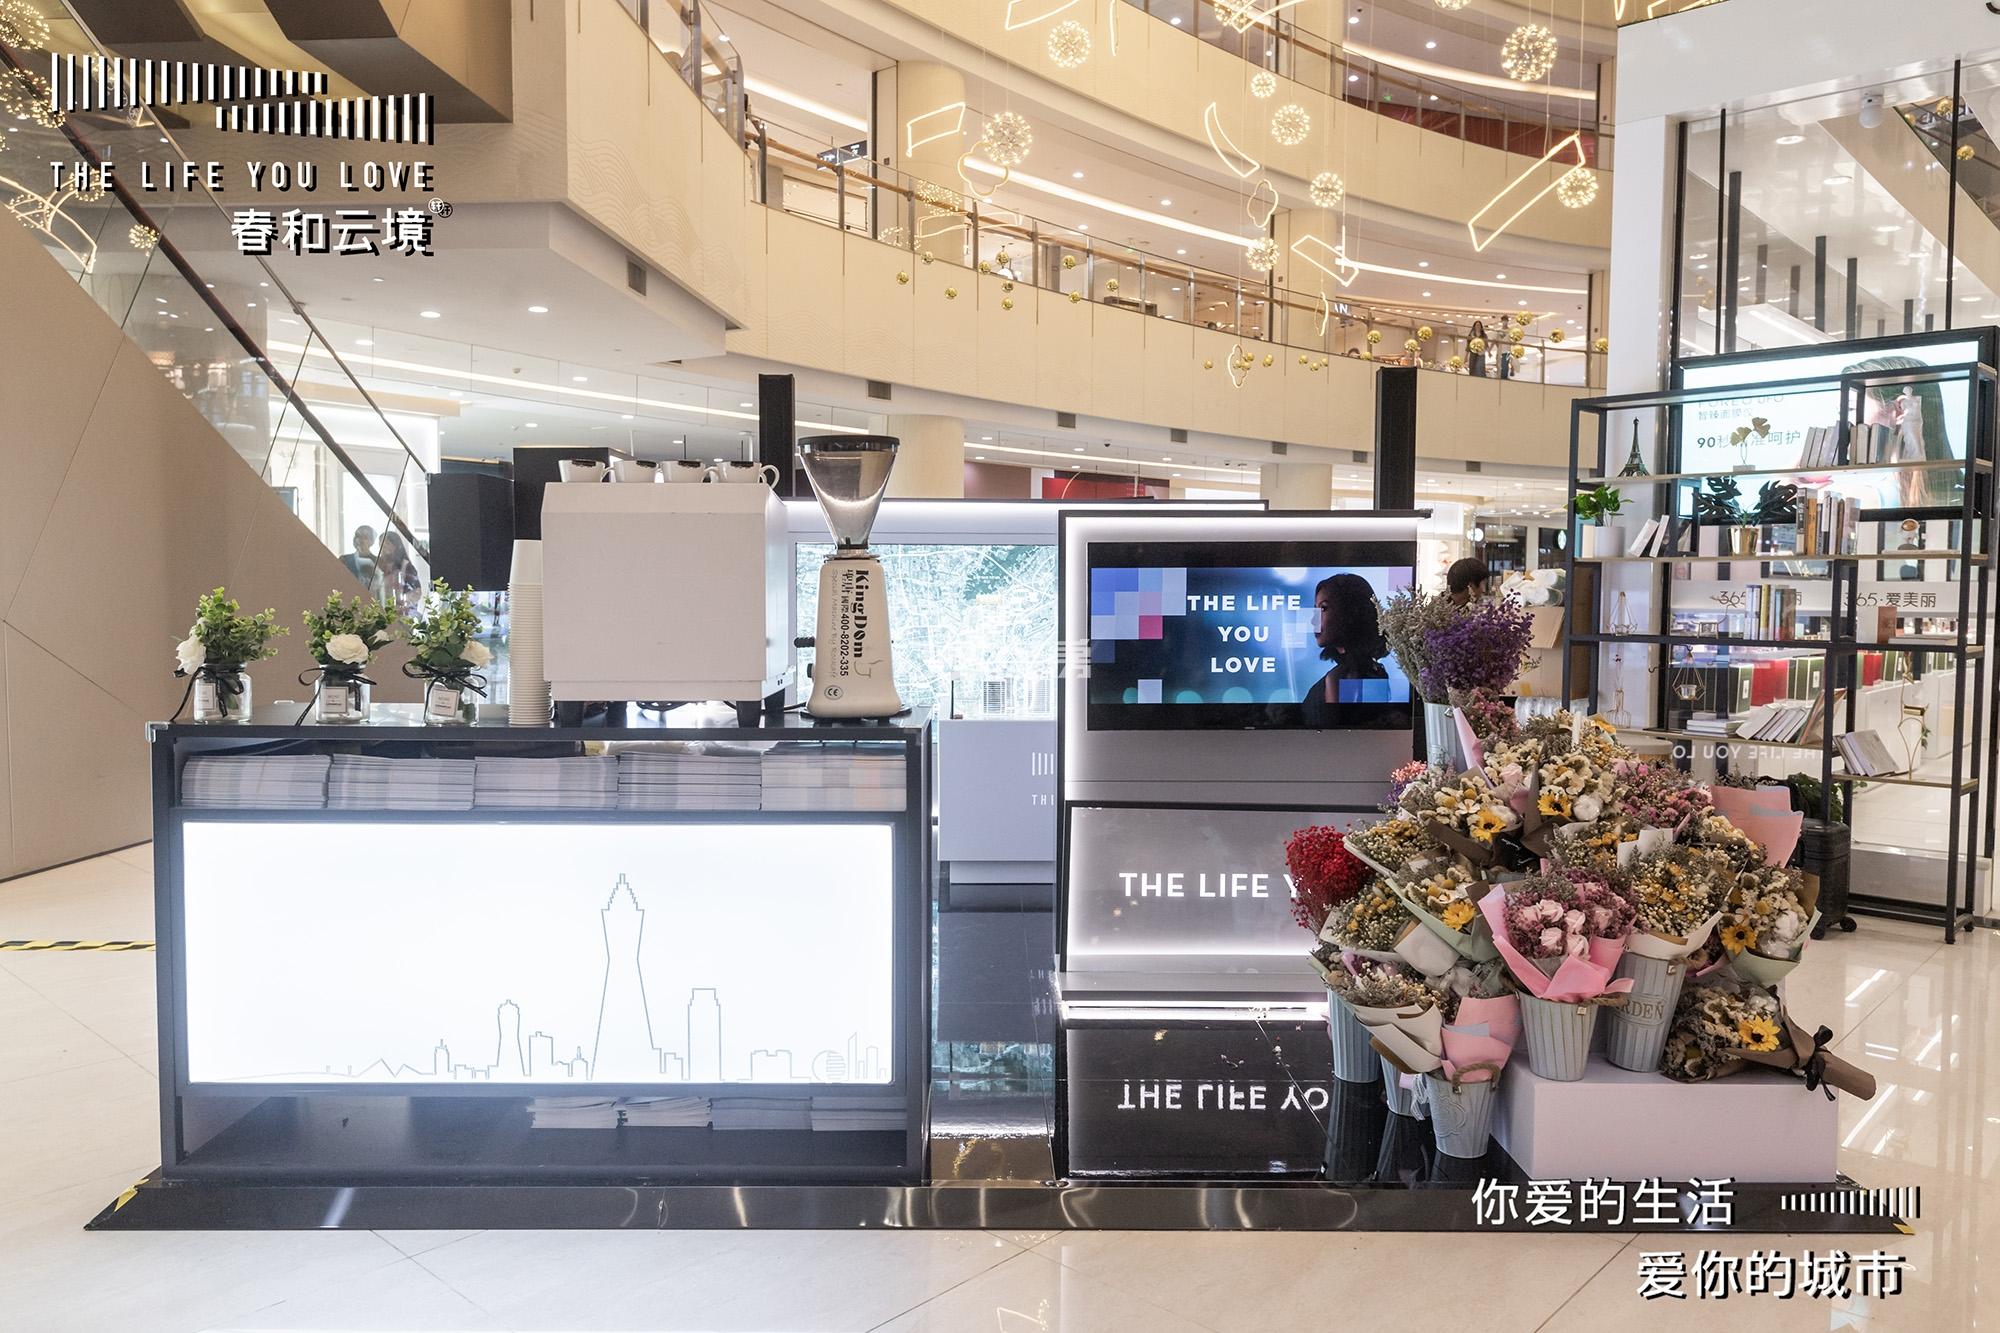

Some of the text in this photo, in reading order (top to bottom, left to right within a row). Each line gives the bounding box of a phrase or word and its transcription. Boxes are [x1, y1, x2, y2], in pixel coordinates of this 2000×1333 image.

[1187, 595, 1300, 611] THE LIFE
[1218, 626, 1269, 642] YOU
[1211, 657, 1276, 673] LOVE
[1119, 873, 1185, 897] THE
[1199, 873, 1269, 897] LIFE
